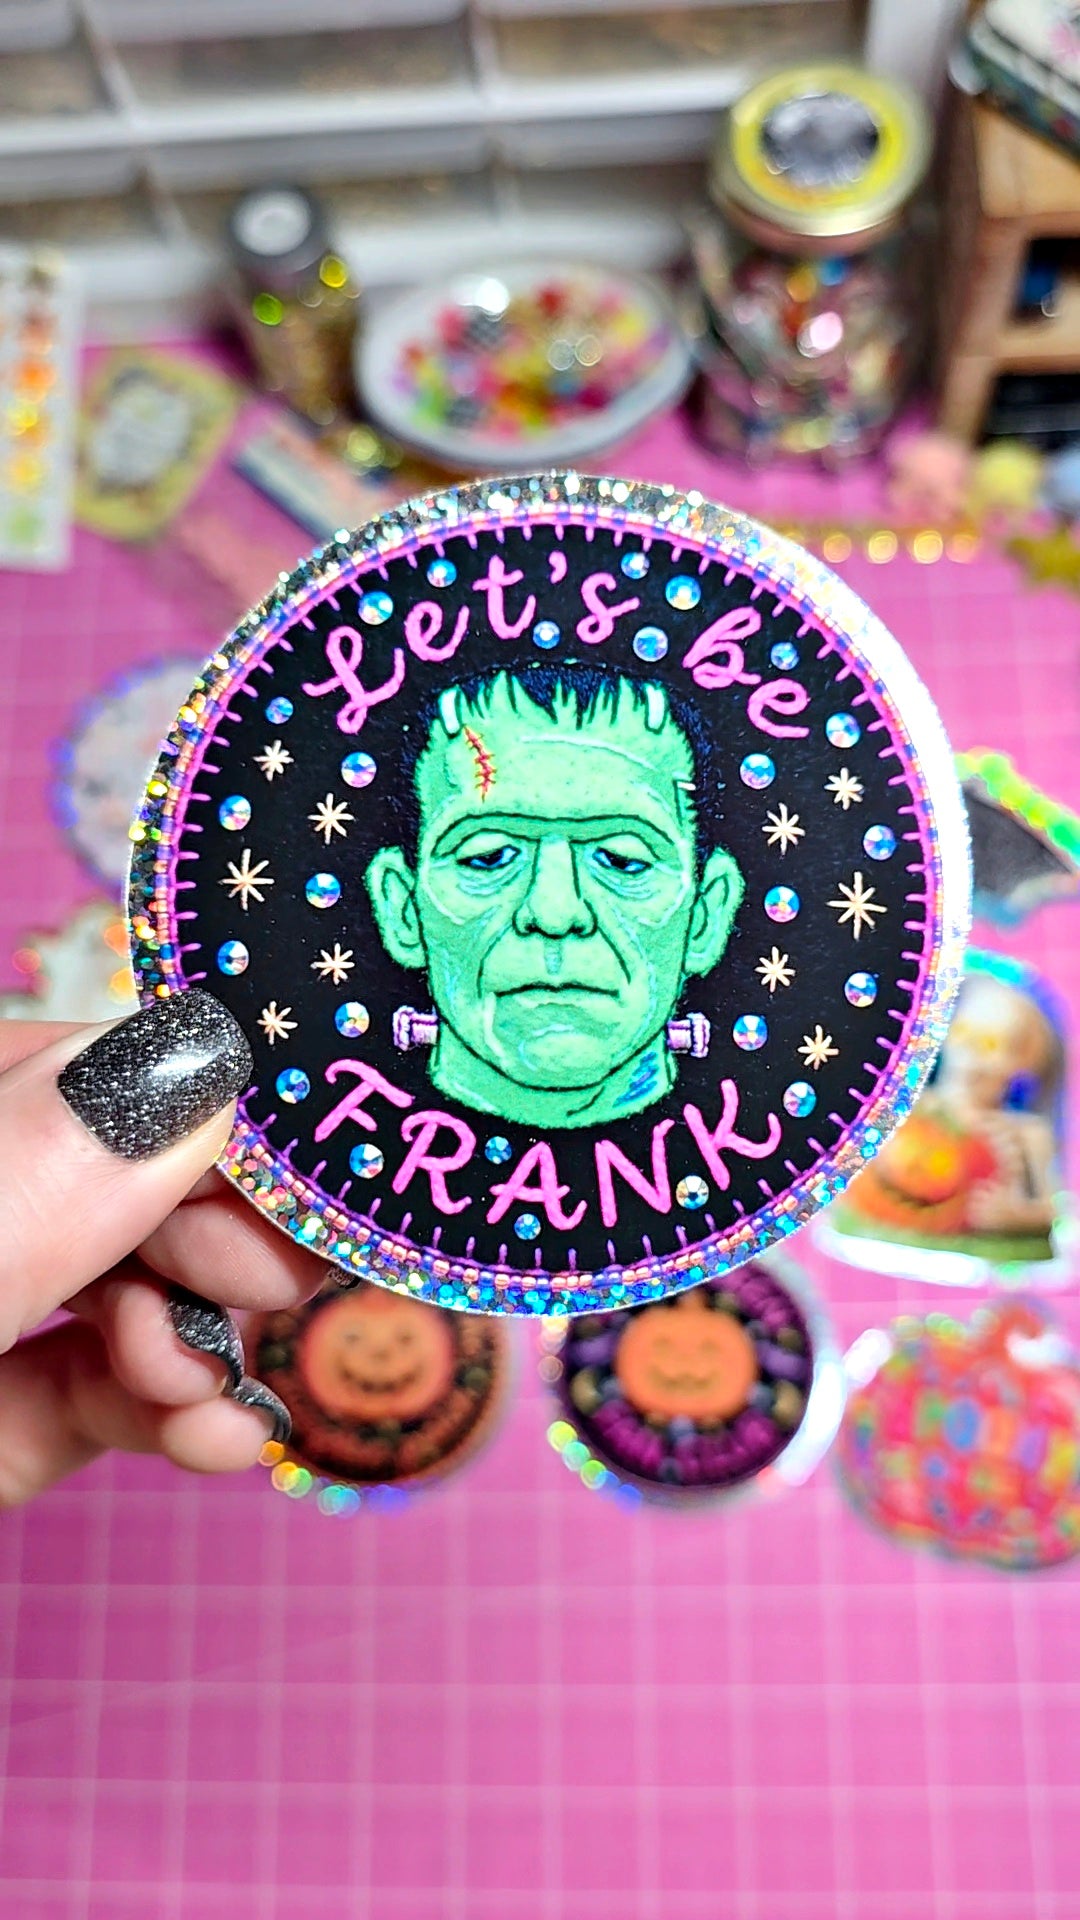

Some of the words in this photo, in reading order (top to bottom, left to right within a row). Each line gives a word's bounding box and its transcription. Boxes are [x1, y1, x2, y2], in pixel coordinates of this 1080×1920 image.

[302, 550, 640, 735] Let's
[682, 606, 811, 738] be
[314, 1058, 782, 1231] FRANK
